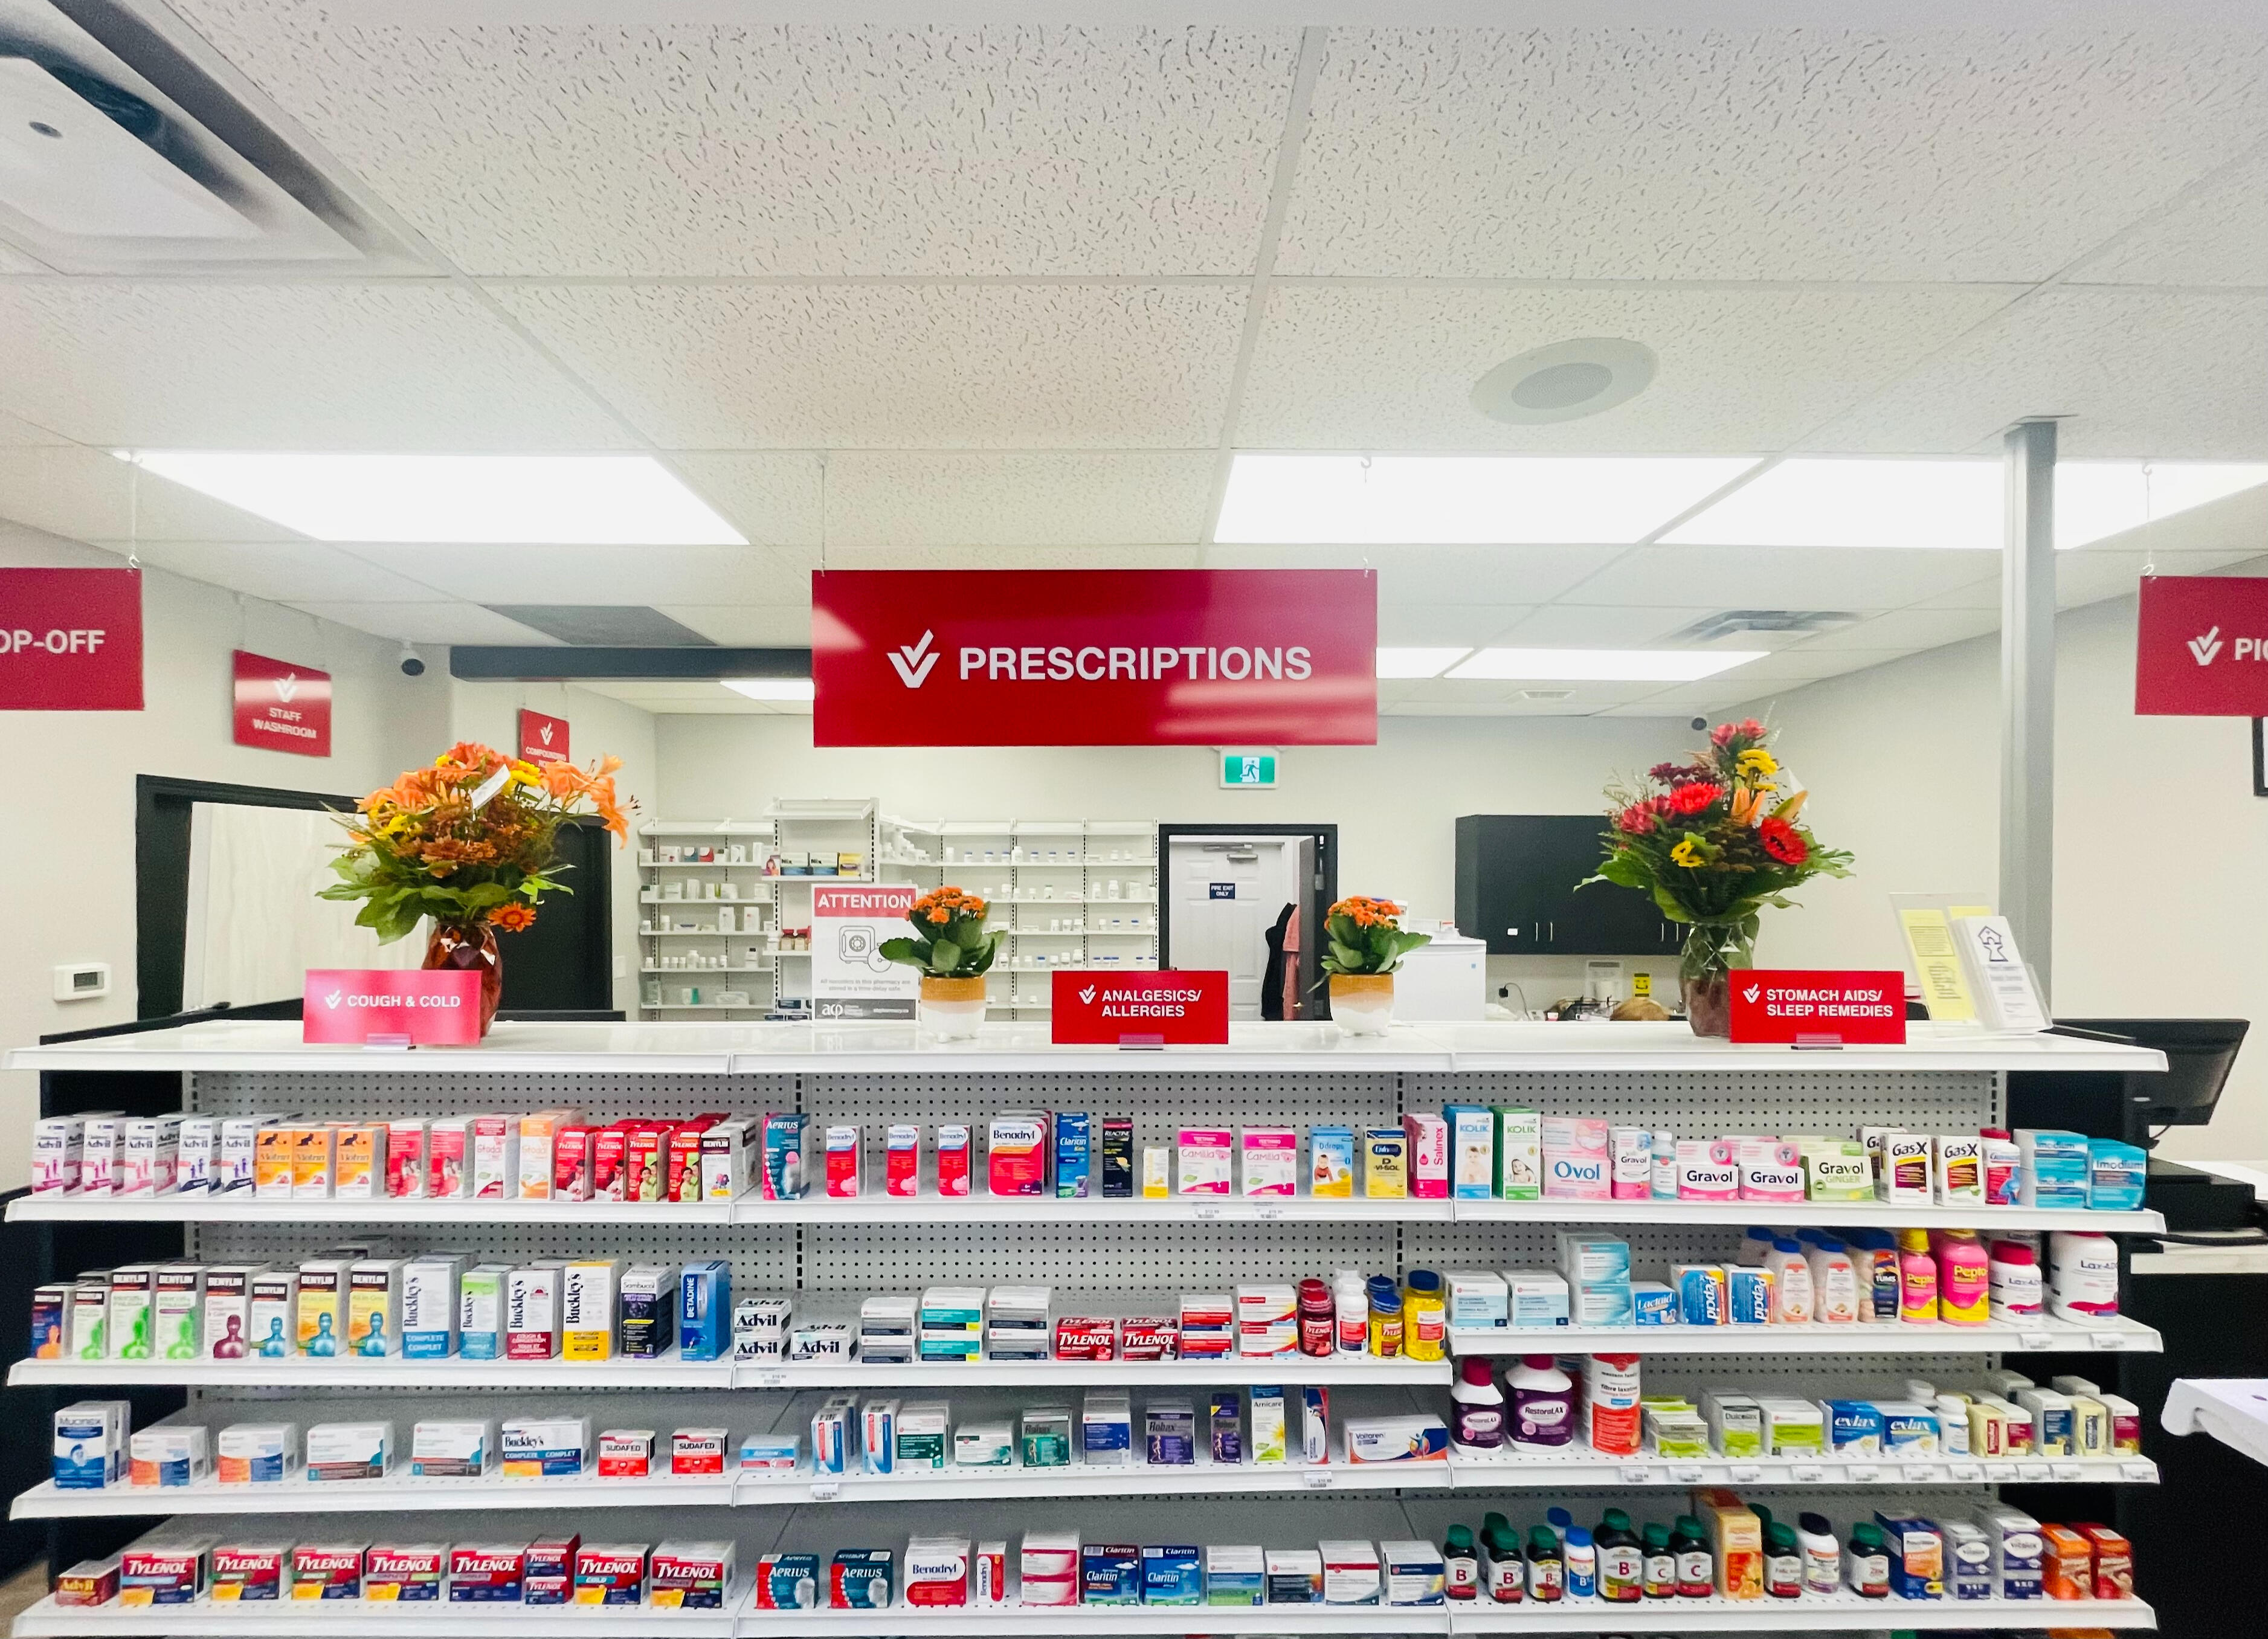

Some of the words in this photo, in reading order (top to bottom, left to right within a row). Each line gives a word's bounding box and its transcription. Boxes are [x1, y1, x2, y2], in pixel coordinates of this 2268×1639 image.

[959, 646, 1312, 680] PRESCRIPTIONS
[269, 707, 301, 722] STAFF
[252, 718, 317, 738] WASHROOM
[818, 894, 912, 909] ATTENTION
[347, 995, 401, 1008] COUGH
[405, 995, 415, 1008] &
[419, 996, 460, 1008] COLD
[1101, 990, 1202, 1002] ANALGESICS/
[1766, 989, 1839, 1002] STOMACH
[1843, 990, 1883, 1002] AIDS/
[1101, 1005, 1185, 1017] ALLERGIES
[1767, 1005, 1814, 1017] SLEEP
[1818, 1005, 1893, 1017] REMEDIES
[993, 1130, 1035, 1141] Benadryl
[1060, 1137, 1087, 1146] Claritin
[558, 1142, 584, 1151] TYLENOL
[596, 1142, 623, 1151] TYLENOL
[1434, 1127, 1443, 1166] Salinex
[1621, 1156, 1647, 1164] Gravol
[2096, 1161, 2144, 1171] Imodium
[1554, 1161, 1600, 1180] Ovol
[1819, 1162, 1864, 1175] Gravol
[1687, 1170, 1733, 1183] Gravol
[1751, 1171, 1798, 1185] Gravol
[1825, 1175, 1861, 1183] GINGER
[1954, 1265, 1987, 1279] Pepto
[352, 1275, 385, 1284] BENYLIN
[1907, 1274, 1936, 1284] Pepto
[404, 1277, 422, 1327] Buckley's
[509, 1280, 527, 1328] Buckley's
[566, 1274, 584, 1324] Buckley's
[686, 1278, 695, 1318] BETADINE
[1638, 1292, 1673, 1310] Lactaid
[1705, 1276, 1719, 1320] Pepcid
[1753, 1277, 1767, 1321] Pepcid
[463, 1290, 474, 1328] Buckley's
[736, 1314, 778, 1326] Advil
[1059, 1332, 1111, 1346] TYLENOL
[1125, 1333, 1174, 1347] TYLENOL
[736, 1342, 778, 1354] Advil
[799, 1341, 840, 1353] Advil
[1149, 1422, 1176, 1432] Robax
[505, 1436, 544, 1447] Buckley's
[530, 1554, 561, 1562] TYLENOL
[1165, 1547, 1196, 1556] Claritin
[128, 1560, 187, 1575] TYLENOL
[216, 1556, 274, 1571] TYLENOL
[297, 1556, 355, 1571] TYLENOL
[373, 1557, 433, 1572] TYLENOL
[456, 1557, 516, 1572] TYLENOL
[581, 1559, 637, 1575] TYLENOL
[912, 1563, 957, 1574] Benadryl
[657, 1562, 715, 1579] TYLENOL
[769, 1566, 810, 1577] AERIUS
[842, 1567, 883, 1578] AERIUS
[1087, 1571, 1118, 1583] Claritin
[980, 1562, 988, 1597] Benadryl
[1148, 1572, 1179, 1583] Claritin
[529, 1582, 561, 1591] TYLENOL
